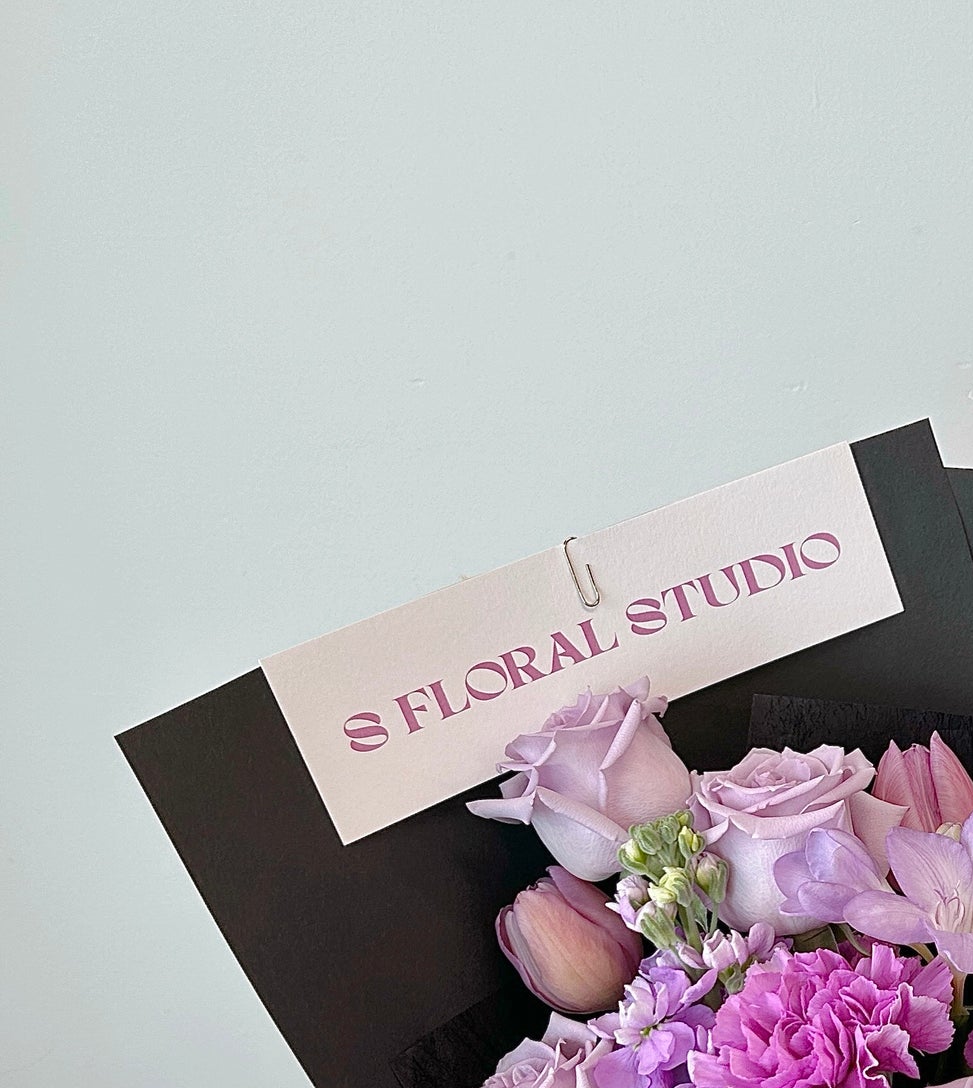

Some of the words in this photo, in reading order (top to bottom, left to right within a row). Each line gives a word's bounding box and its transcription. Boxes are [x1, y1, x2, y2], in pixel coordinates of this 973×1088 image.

[344, 712, 388, 753] S
[394, 620, 619, 734] FLORAL
[625, 532, 841, 637] STUDIO
